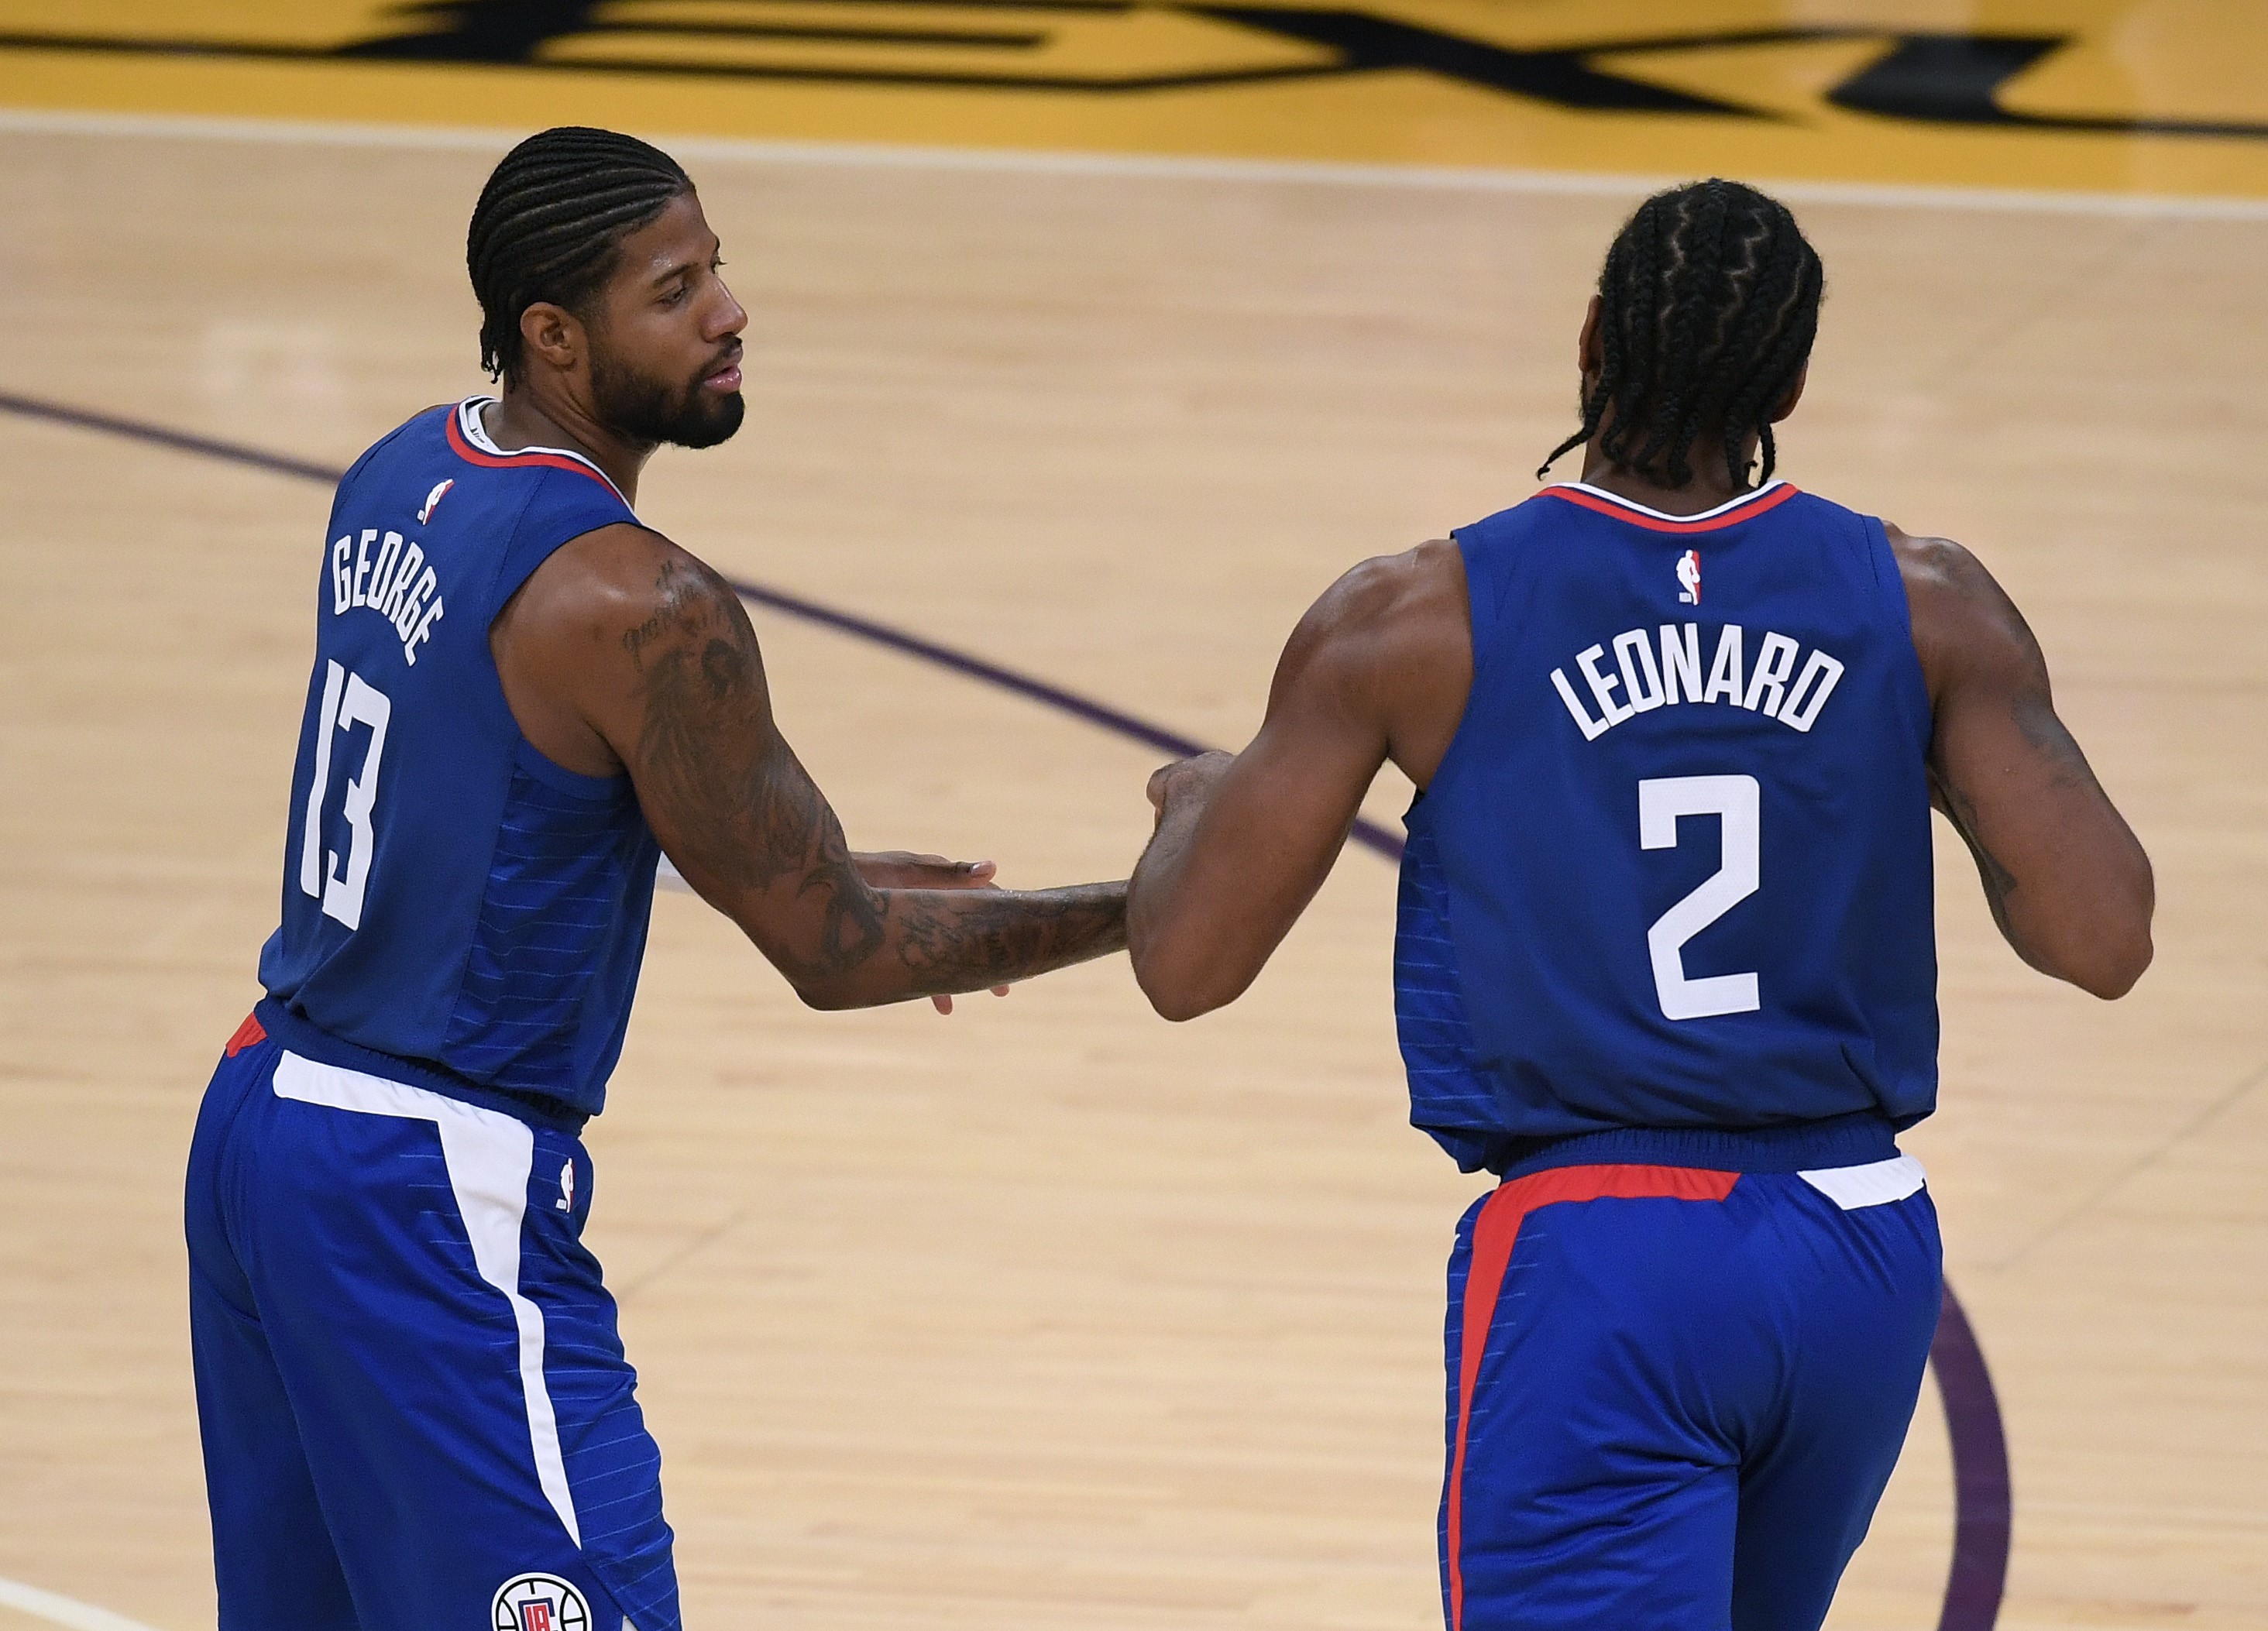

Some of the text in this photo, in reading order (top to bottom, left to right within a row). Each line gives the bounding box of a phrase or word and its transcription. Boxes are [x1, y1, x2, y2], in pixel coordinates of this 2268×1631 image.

[332, 529, 444, 666] GEORGE
[1550, 623, 1845, 742] LEONARD
[301, 658, 390, 932] 13
[1638, 774, 1760, 1020] 2
